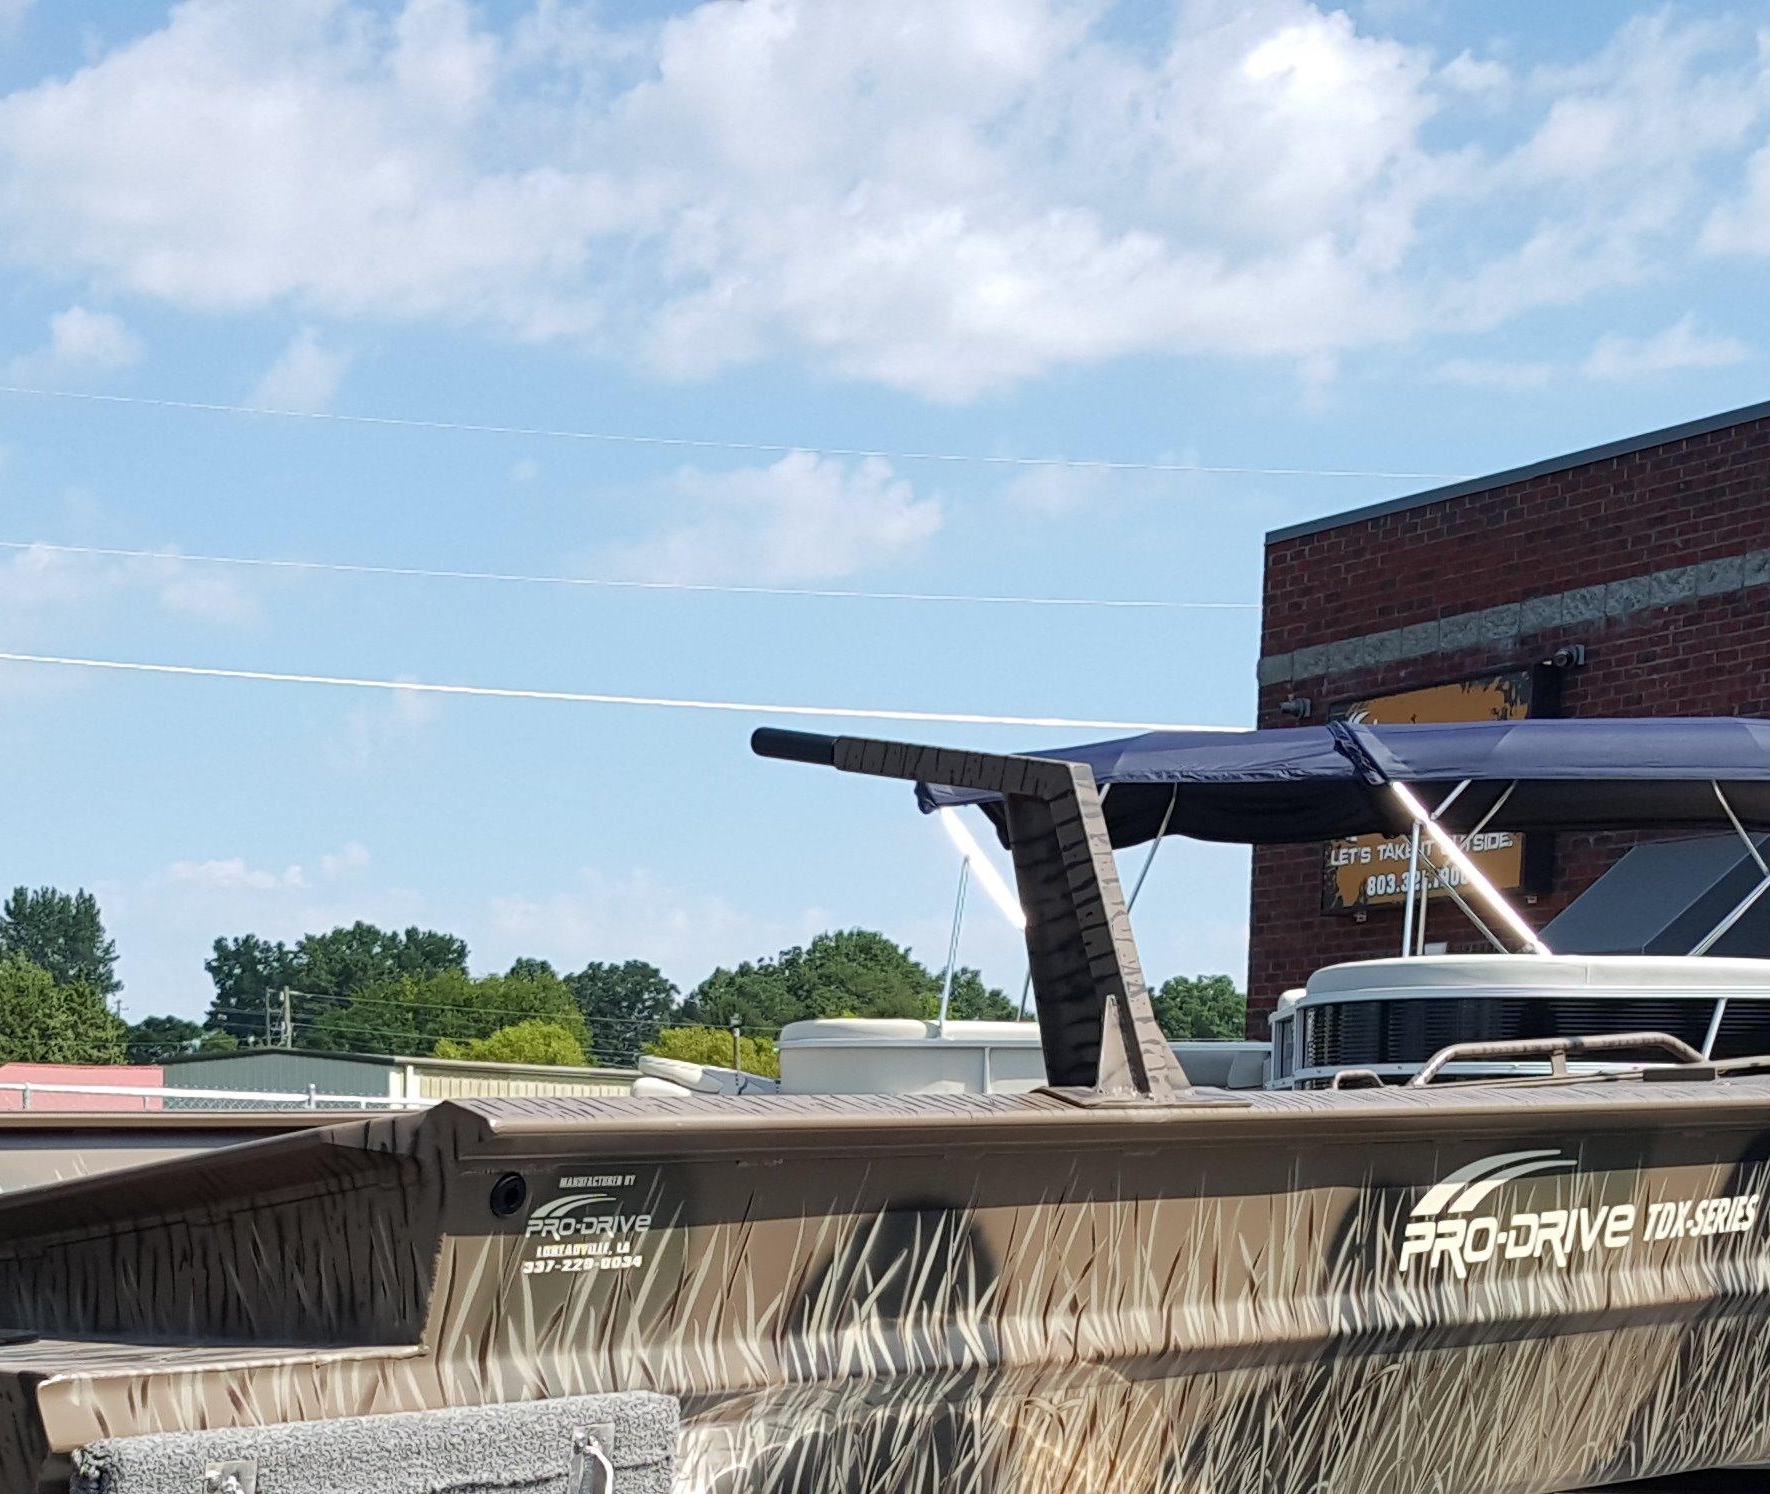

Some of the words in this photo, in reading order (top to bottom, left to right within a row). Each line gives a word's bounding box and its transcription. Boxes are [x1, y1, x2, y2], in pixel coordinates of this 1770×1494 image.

[1330, 846, 1372, 866] LET'S
[559, 1175, 623, 1189] MANUFACTURED
[624, 1174, 636, 1186] BY
[1642, 1193, 1760, 1242] TDX-SERIES
[616, 1241, 631, 1254] LA
